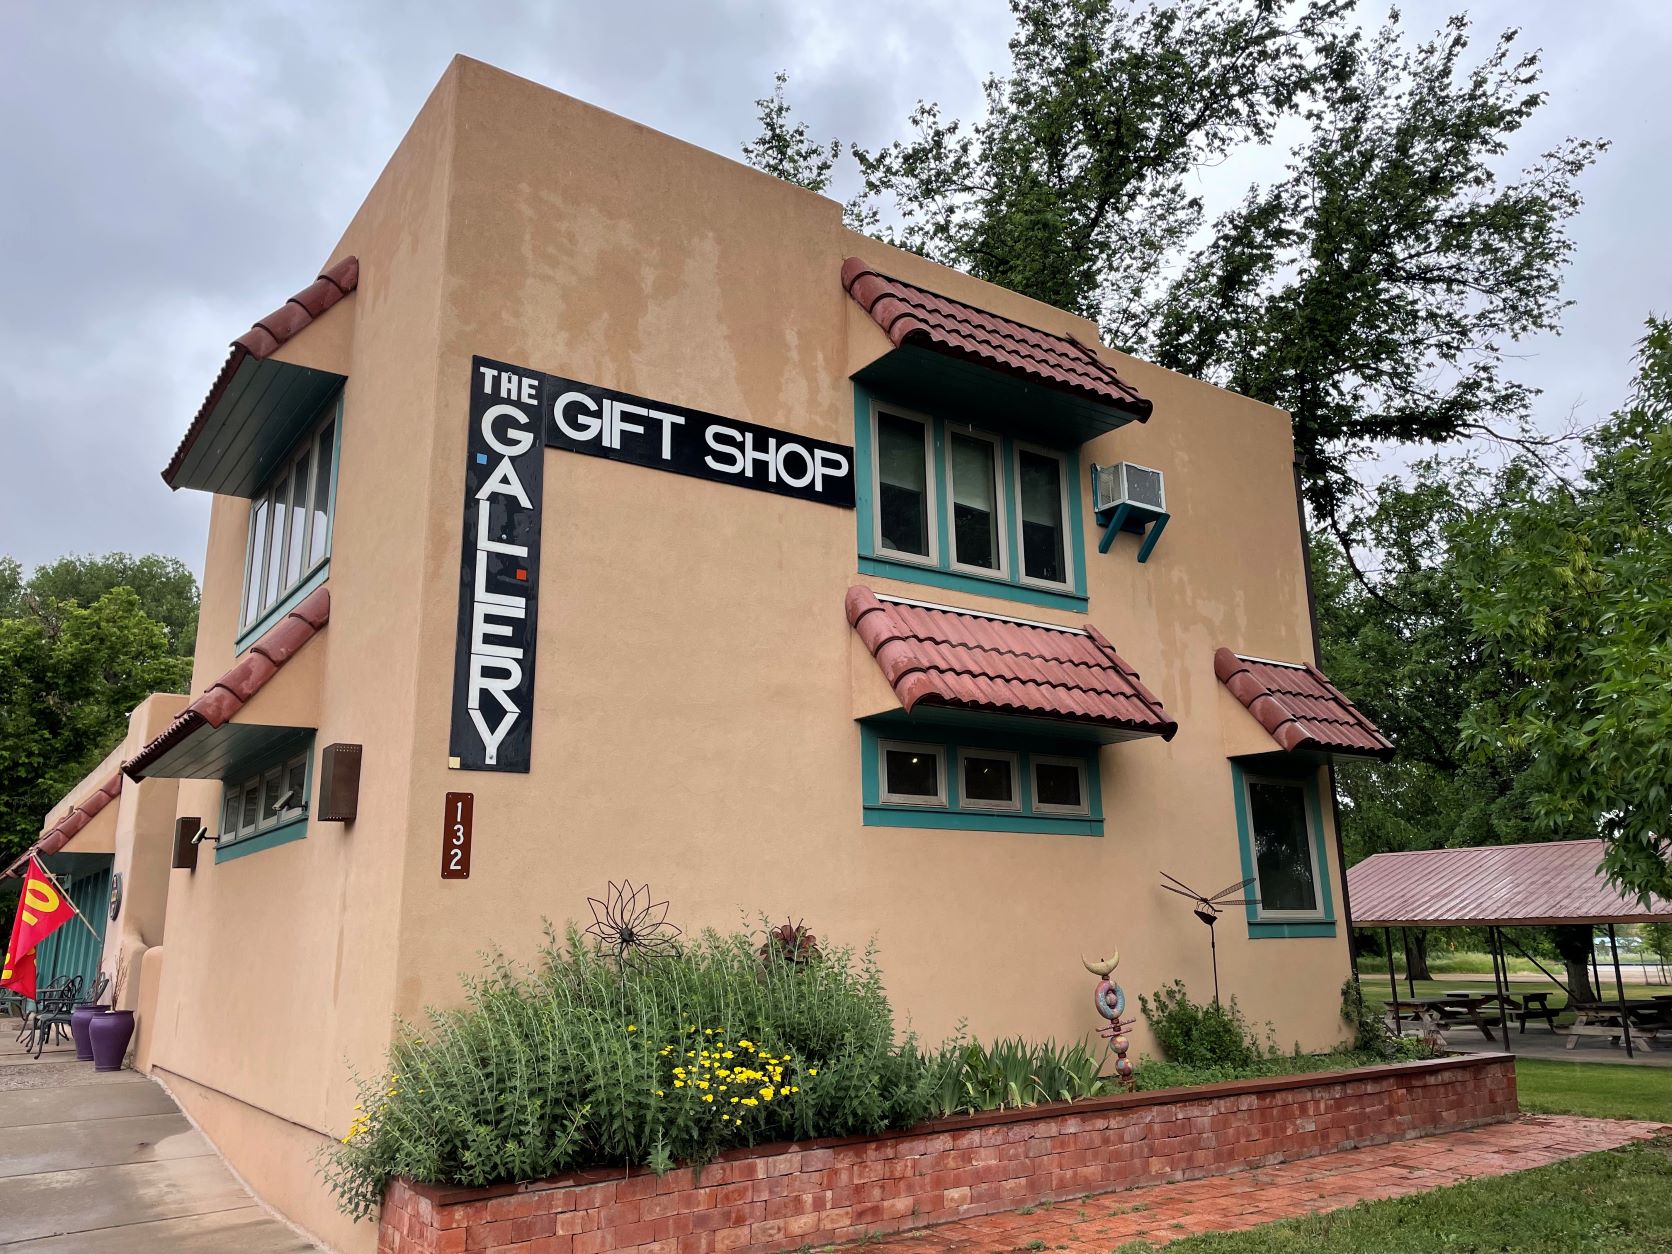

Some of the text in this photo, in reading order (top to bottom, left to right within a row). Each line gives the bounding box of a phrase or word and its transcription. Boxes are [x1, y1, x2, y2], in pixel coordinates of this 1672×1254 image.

[479, 366, 539, 406] THE
[553, 391, 849, 493] GIFT SHOP
[467, 404, 534, 766] GALLERY
[449, 801, 465, 870] 132
